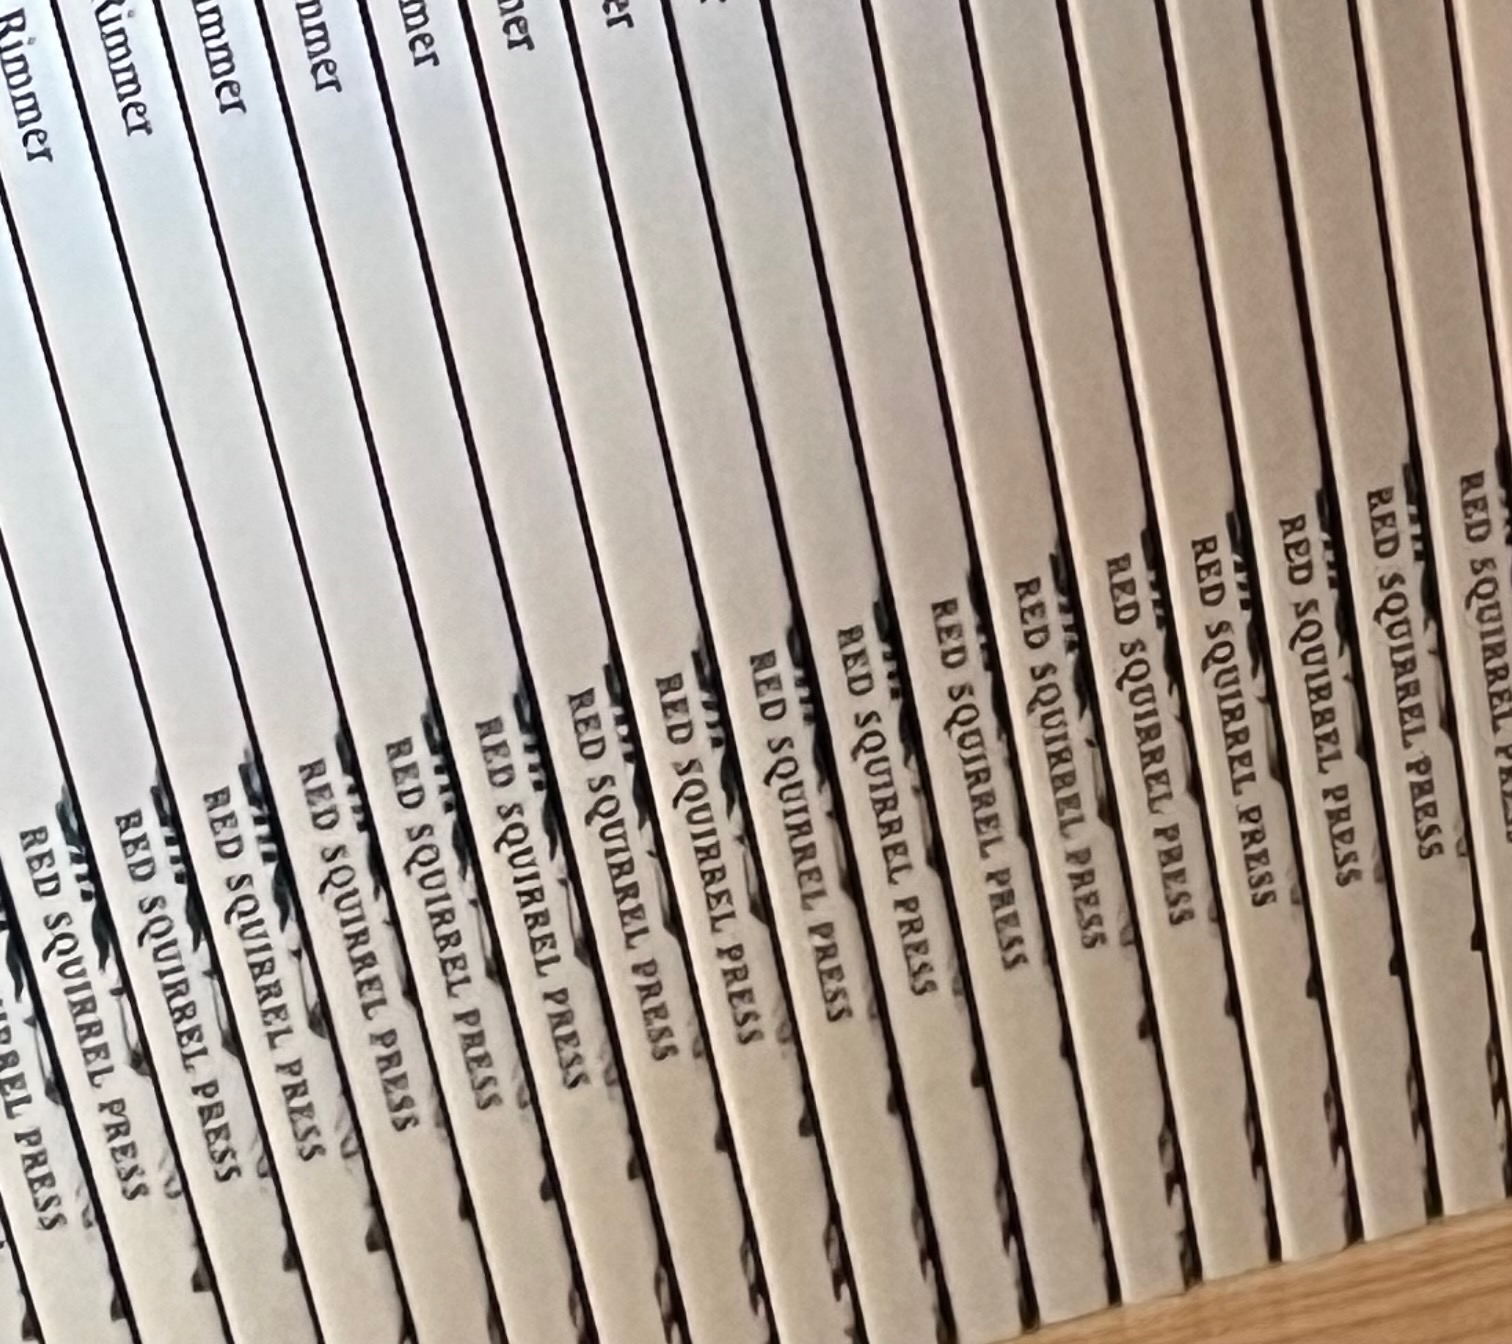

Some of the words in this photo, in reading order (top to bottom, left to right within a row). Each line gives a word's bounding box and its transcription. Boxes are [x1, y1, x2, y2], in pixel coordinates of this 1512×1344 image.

[0, 7, 54, 163] Rimmer
[1277, 513, 1315, 586] RED
[1366, 485, 1401, 560] RED
[1459, 469, 1493, 544] RED
[1013, 575, 1051, 651] RED
[1105, 552, 1141, 626] RED
[1190, 534, 1227, 608] RED
[748, 648, 788, 722] RED
[836, 624, 875, 698] RED
[930, 597, 969, 670] RED
[1372, 571, 1427, 751] SQUIRREL
[565, 686, 607, 762] RED
[654, 671, 695, 746] RED
[1114, 637, 1174, 815] SQUIRREL
[1200, 619, 1257, 797] SQUIRREL
[1287, 597, 1343, 776] SQUIRREL
[297, 757, 341, 832] RED
[384, 735, 427, 811] RED
[474, 715, 517, 789] RED
[849, 709, 914, 886] SQUIRREL
[942, 681, 1004, 861] SQUIRREL
[1025, 661, 1086, 840] SQUIRREL
[202, 784, 245, 861] RED
[671, 757, 737, 935] SQUIRREL
[762, 735, 828, 912] SQUIRREL
[1235, 804, 1278, 908] PRESS
[1321, 783, 1363, 888] PRESS
[1404, 754, 1445, 861] PRESS
[402, 823, 473, 999] SQUIRREL
[491, 801, 562, 979] SQUIRREL
[583, 774, 651, 951] SQUIRREL
[1064, 845, 1108, 950] PRESS
[1152, 822, 1196, 927] PRESS
[223, 872, 295, 1052] SQUIRREL
[317, 843, 389, 1022] SQUIRREL
[892, 894, 939, 997] PRESS
[984, 866, 1030, 972] PRESS
[18, 825, 62, 900] RED
[41, 911, 115, 1090] SQUIRREL
[97, 1097, 151, 1202] PRESS
[113, 807, 158, 884] RED
[136, 894, 209, 1074] SQUIRREL
[190, 1077, 243, 1184] PRESS
[630, 957, 680, 1062] PRESS
[714, 942, 765, 1046] PRESS
[806, 921, 854, 1024] PRESS
[368, 1027, 421, 1133] PRESS
[452, 1007, 504, 1111] PRESS
[541, 986, 591, 1091] PRESS
[274, 1056, 327, 1163] PRESS
[13, 1126, 68, 1231] PRESS
